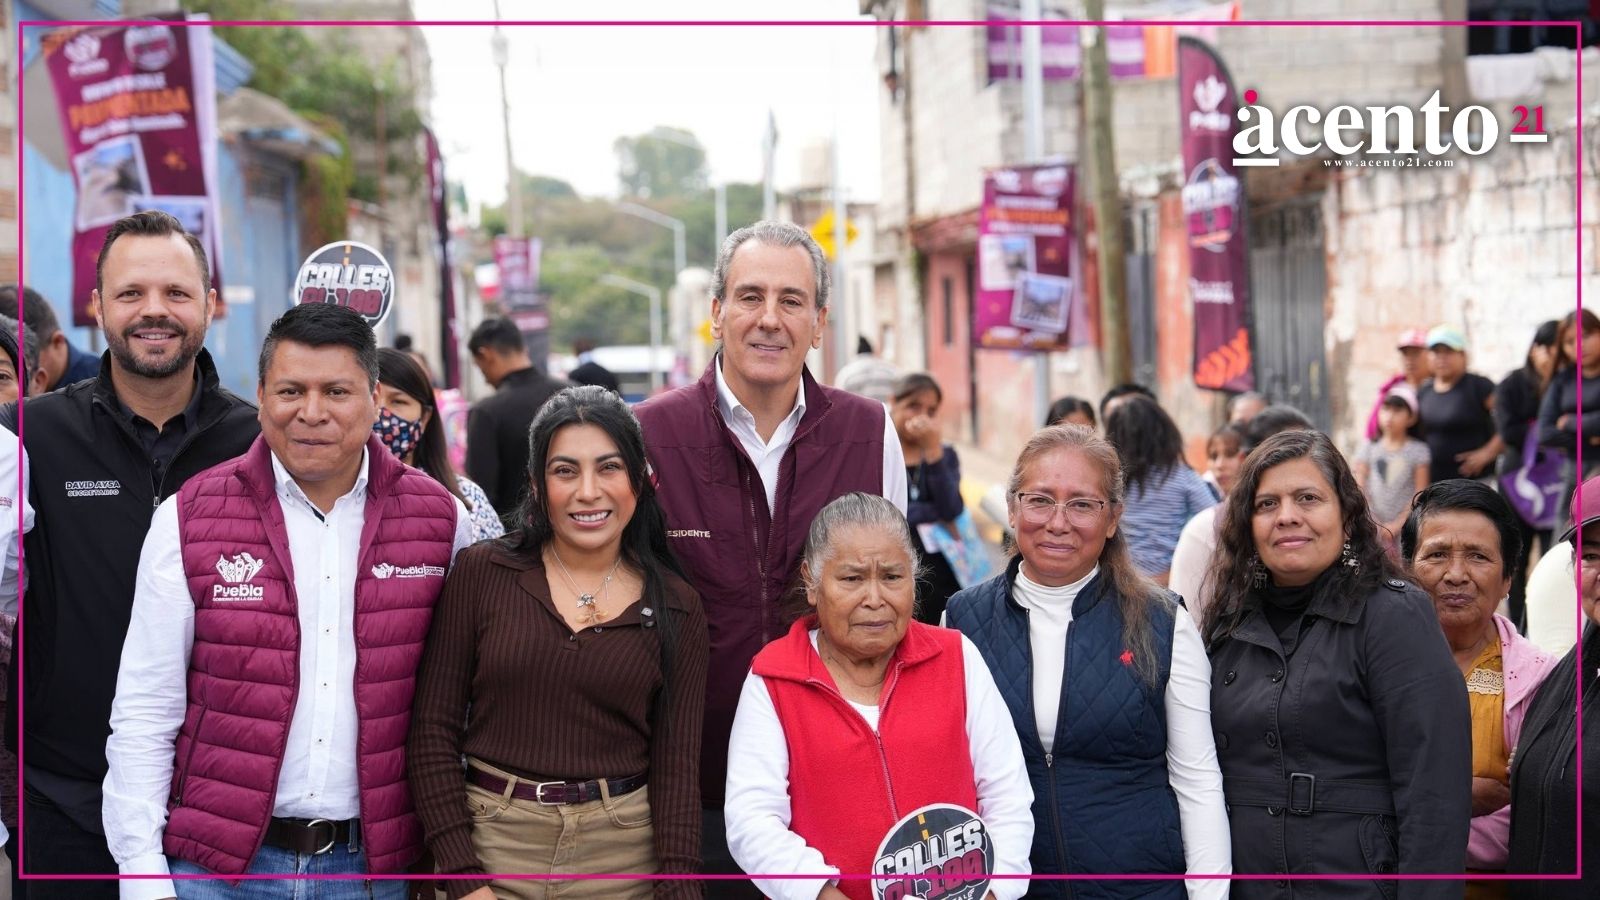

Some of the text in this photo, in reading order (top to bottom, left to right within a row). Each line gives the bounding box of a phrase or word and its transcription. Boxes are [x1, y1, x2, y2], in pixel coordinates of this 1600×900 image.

[300, 263, 388, 288] CALLES
[65, 480, 121, 490] DAVID AYSA
[67, 489, 120, 497] SECRETARIO
[665, 529, 711, 538] ESIDENTE
[396, 565, 424, 575] Puebla
[213, 584, 264, 598] Puebla
[874, 819, 985, 890] CALLES
[924, 848, 985, 899] 100
